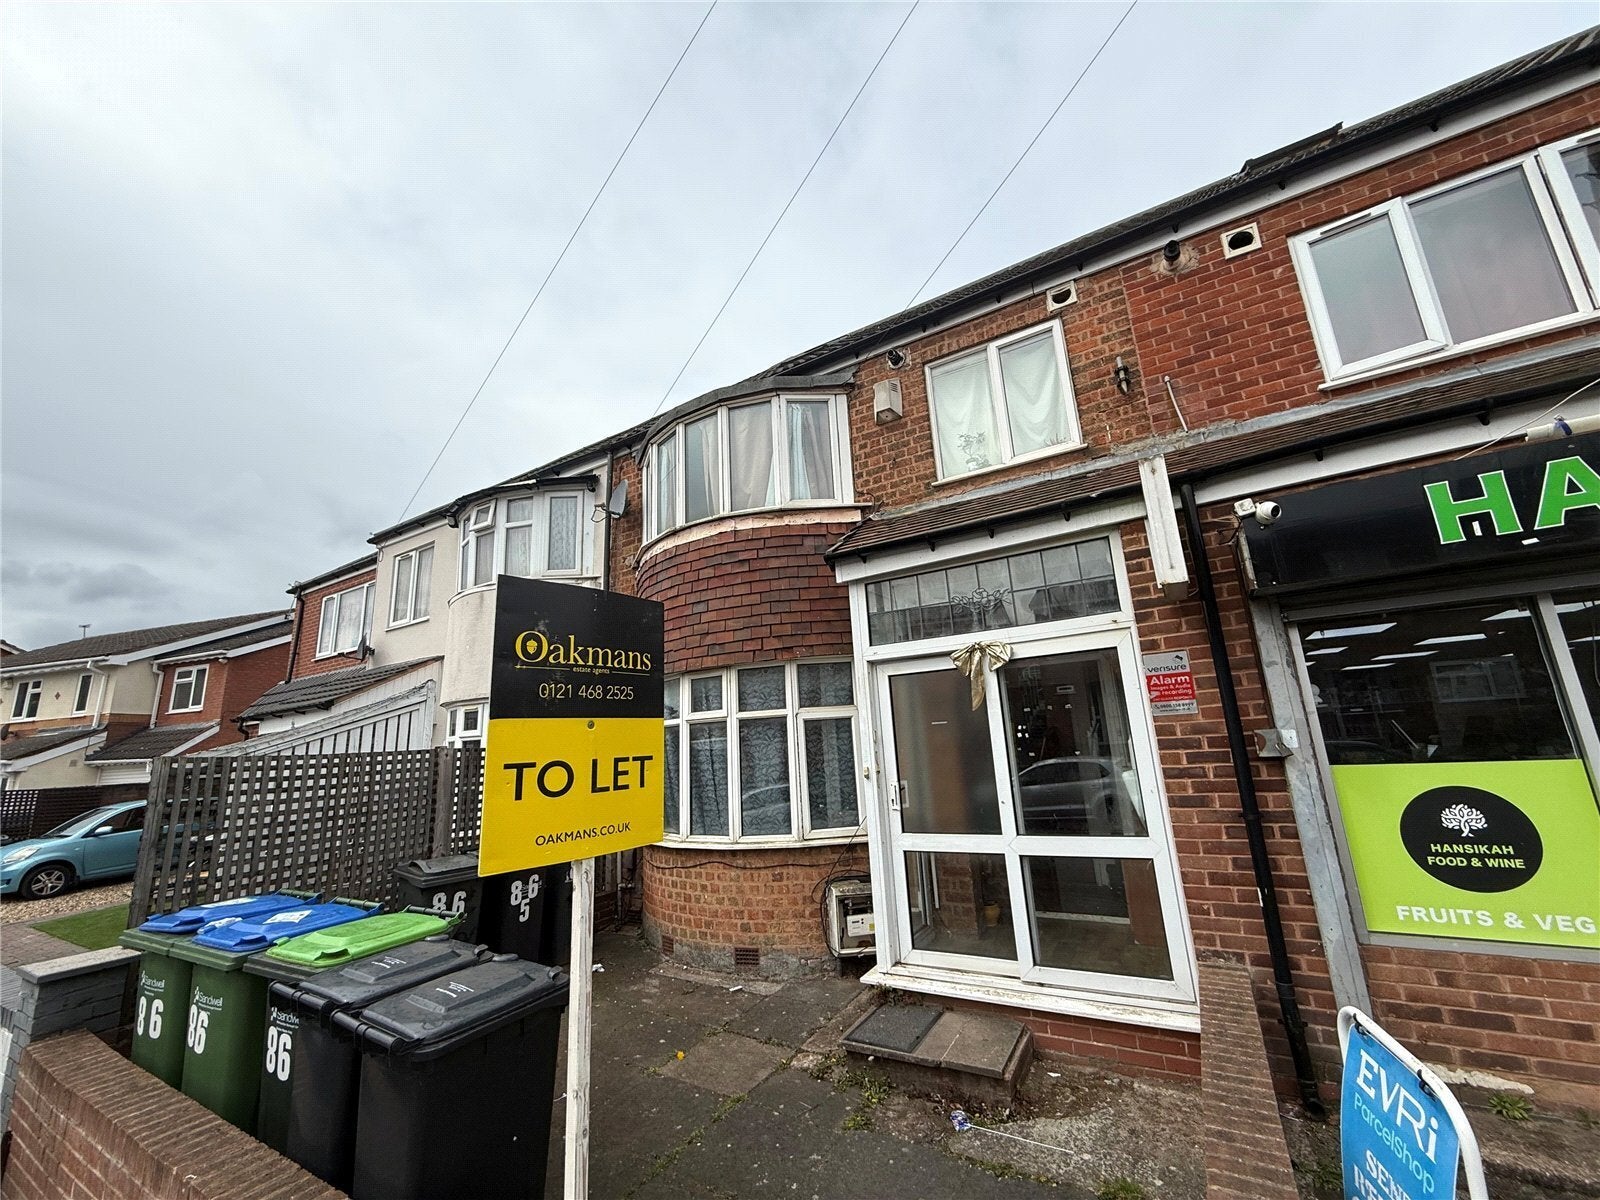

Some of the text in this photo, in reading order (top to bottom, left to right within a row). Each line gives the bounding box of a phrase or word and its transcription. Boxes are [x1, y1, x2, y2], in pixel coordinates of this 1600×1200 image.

[1423, 456, 1600, 545] HA
[515, 630, 652, 671] Oakmans
[592, 667, 610, 675] agents
[1147, 664, 1187, 673] verisure
[1150, 675, 1190, 685] Alarm
[539, 683, 634, 700] 0121 468 2525
[503, 755, 653, 800] TO LET
[535, 821, 631, 846] OAKMANS.CO.UK
[1430, 843, 1515, 855] HANSIKAH
[1427, 856, 1526, 869] FOOD & WINE
[519, 898, 530, 922] 5
[1395, 905, 1598, 935] FRUITS & VEG
[199, 991, 223, 1007] Sandwell
[187, 1004, 209, 1054] 86
[266, 1025, 292, 1081] 86
